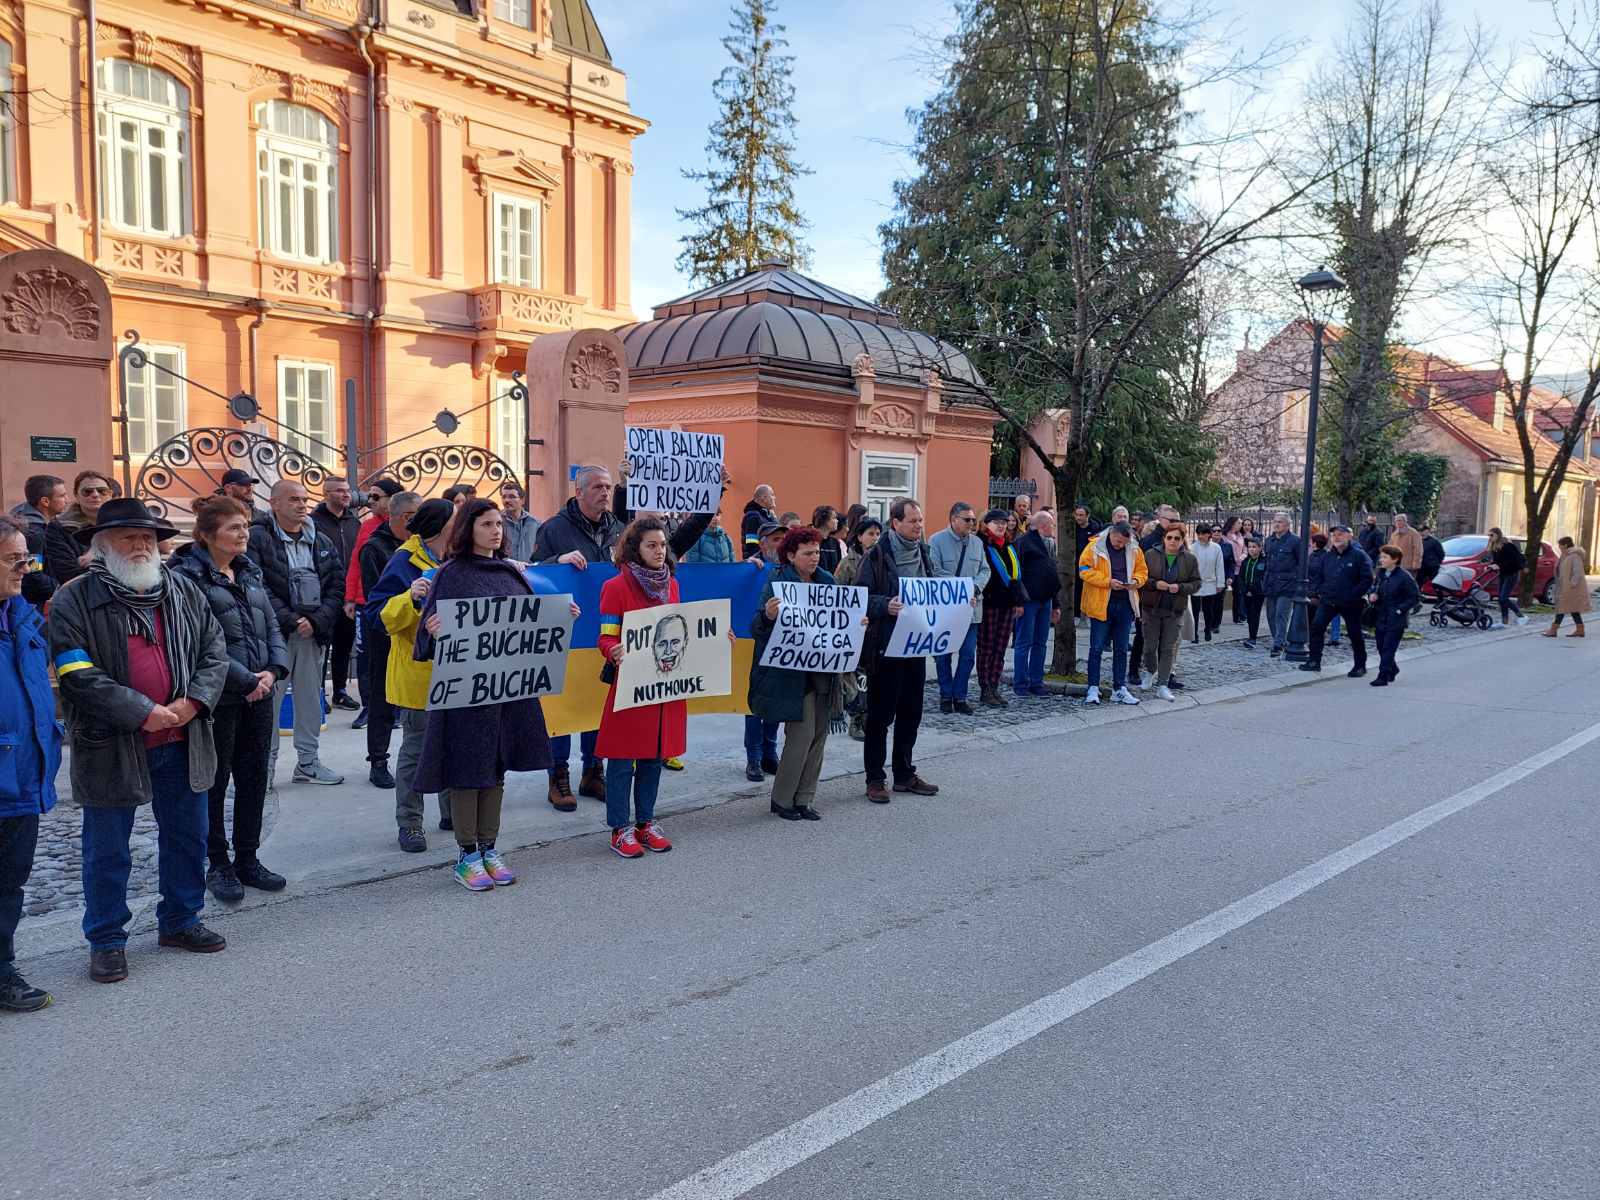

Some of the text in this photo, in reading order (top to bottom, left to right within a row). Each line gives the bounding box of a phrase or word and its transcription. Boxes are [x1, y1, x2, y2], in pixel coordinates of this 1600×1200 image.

[629, 428, 720, 459] OPEN BALKAN
[629, 455, 721, 484] OPENED DOORS
[629, 484, 710, 511] TO RUSSIA
[781, 583, 861, 608] KO NEGIRA
[901, 578, 969, 606] KADIROVA
[455, 597, 540, 629] PUTIN
[780, 606, 849, 630] GENOCID
[925, 609, 936, 626] U
[437, 627, 565, 665] THE BUCHER
[626, 617, 717, 653] PUT IN
[781, 630, 805, 646] TAJ
[832, 634, 852, 648] GA
[903, 630, 951, 655] HAG
[768, 646, 855, 671] PONOVIT
[430, 665, 552, 705] OF BUCHA
[633, 676, 706, 703] NUTHOUSE
